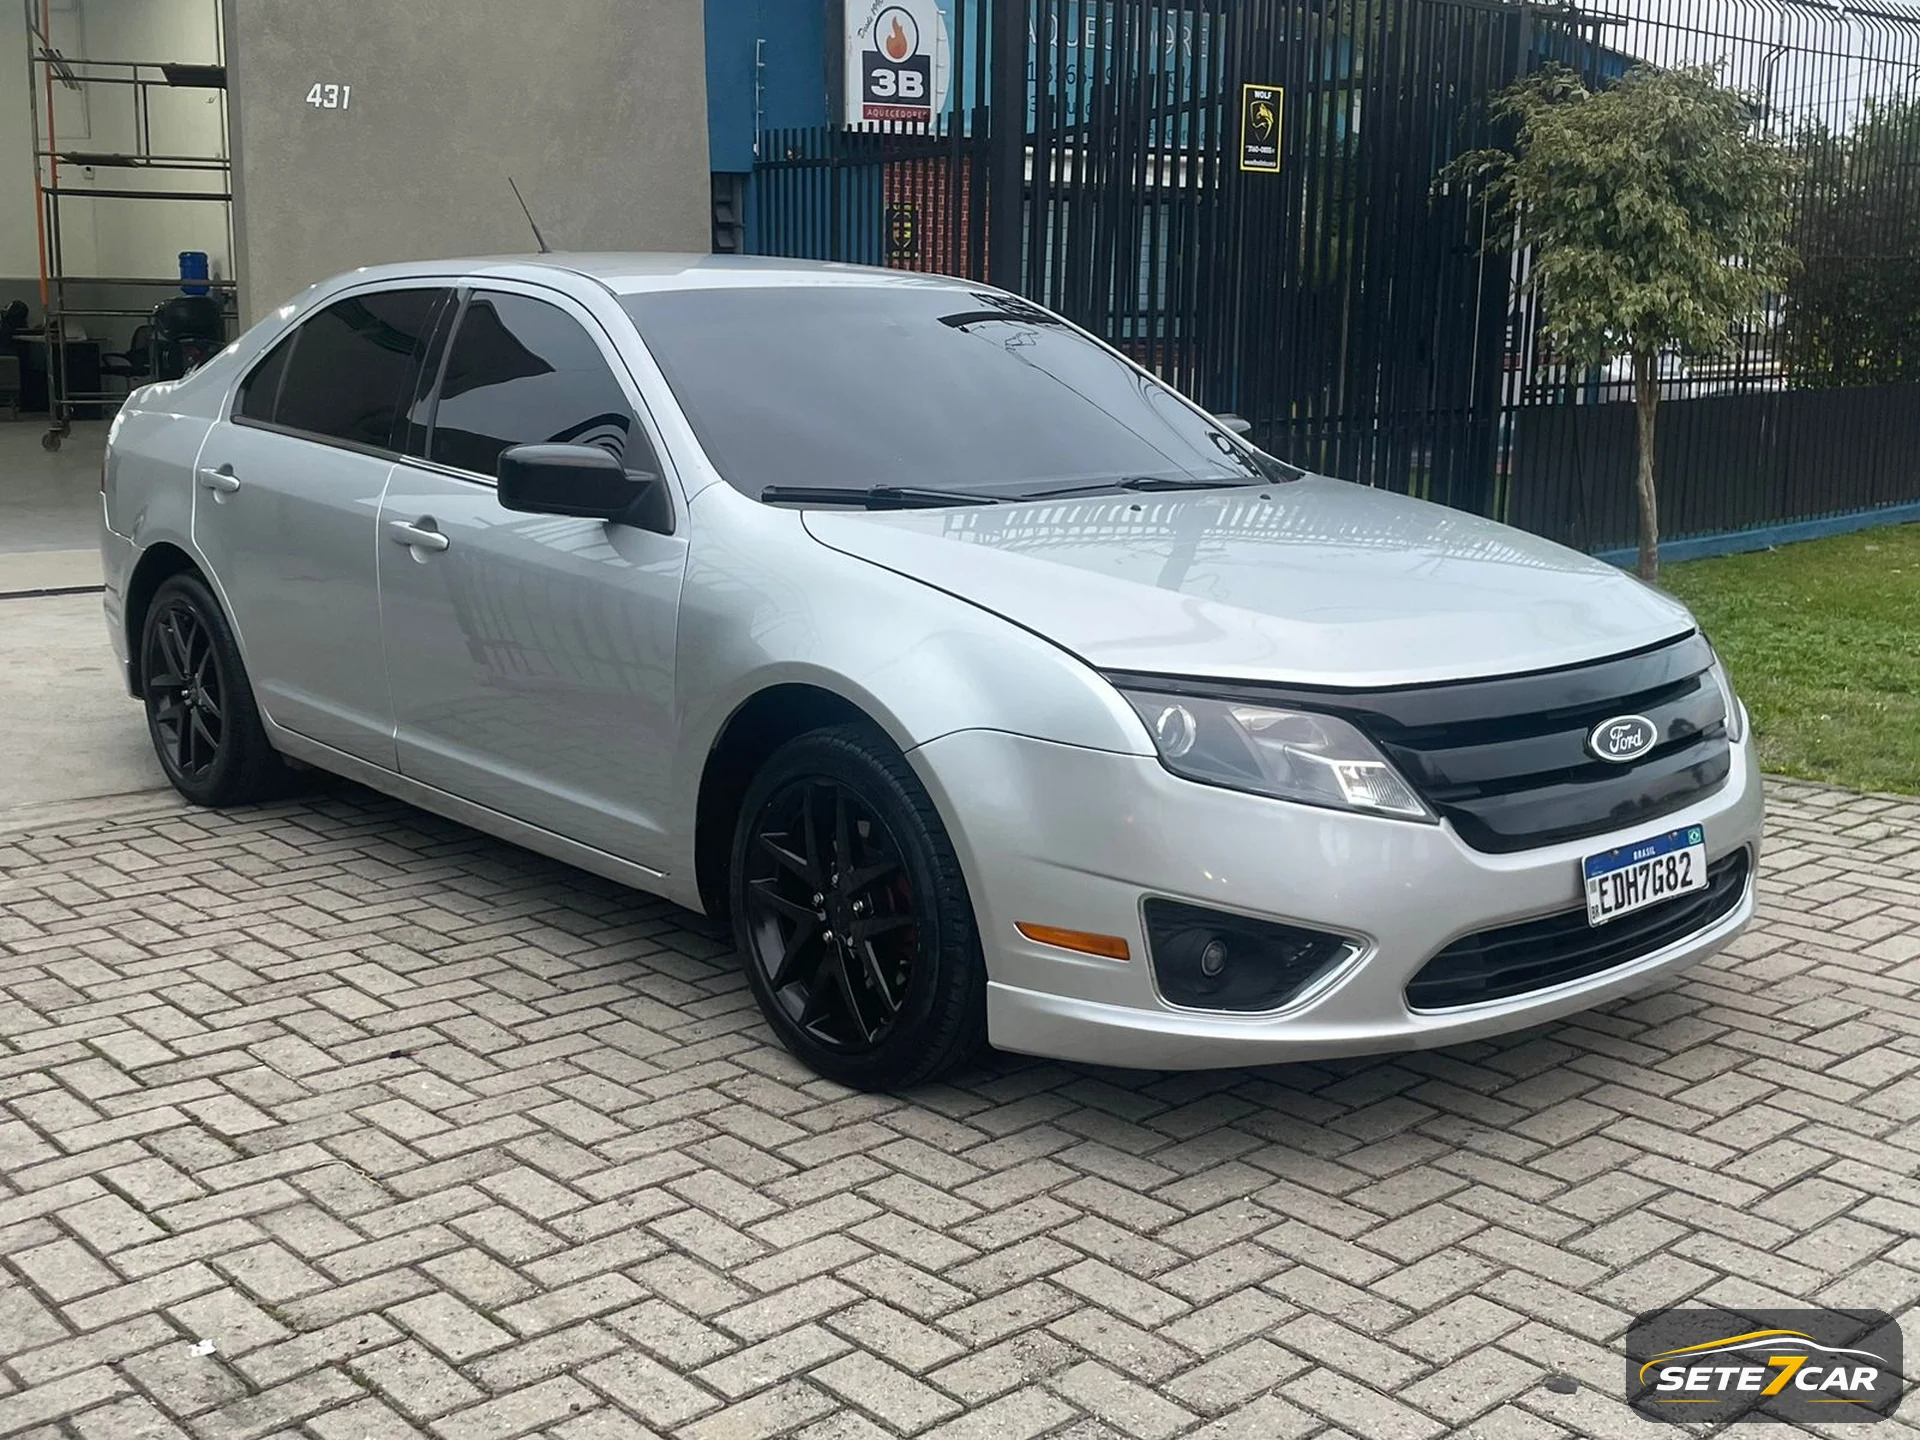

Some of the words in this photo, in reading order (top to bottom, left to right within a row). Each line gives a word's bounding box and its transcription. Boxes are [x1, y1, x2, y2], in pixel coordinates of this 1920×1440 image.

[306, 83, 350, 109] 431
[870, 68, 924, 98] 3B
[1254, 90, 1272, 99] WOLF
[1609, 723, 1643, 753] Ford
[1633, 846, 1656, 861] BRASIL
[1598, 851, 1693, 915] EDH7G82
